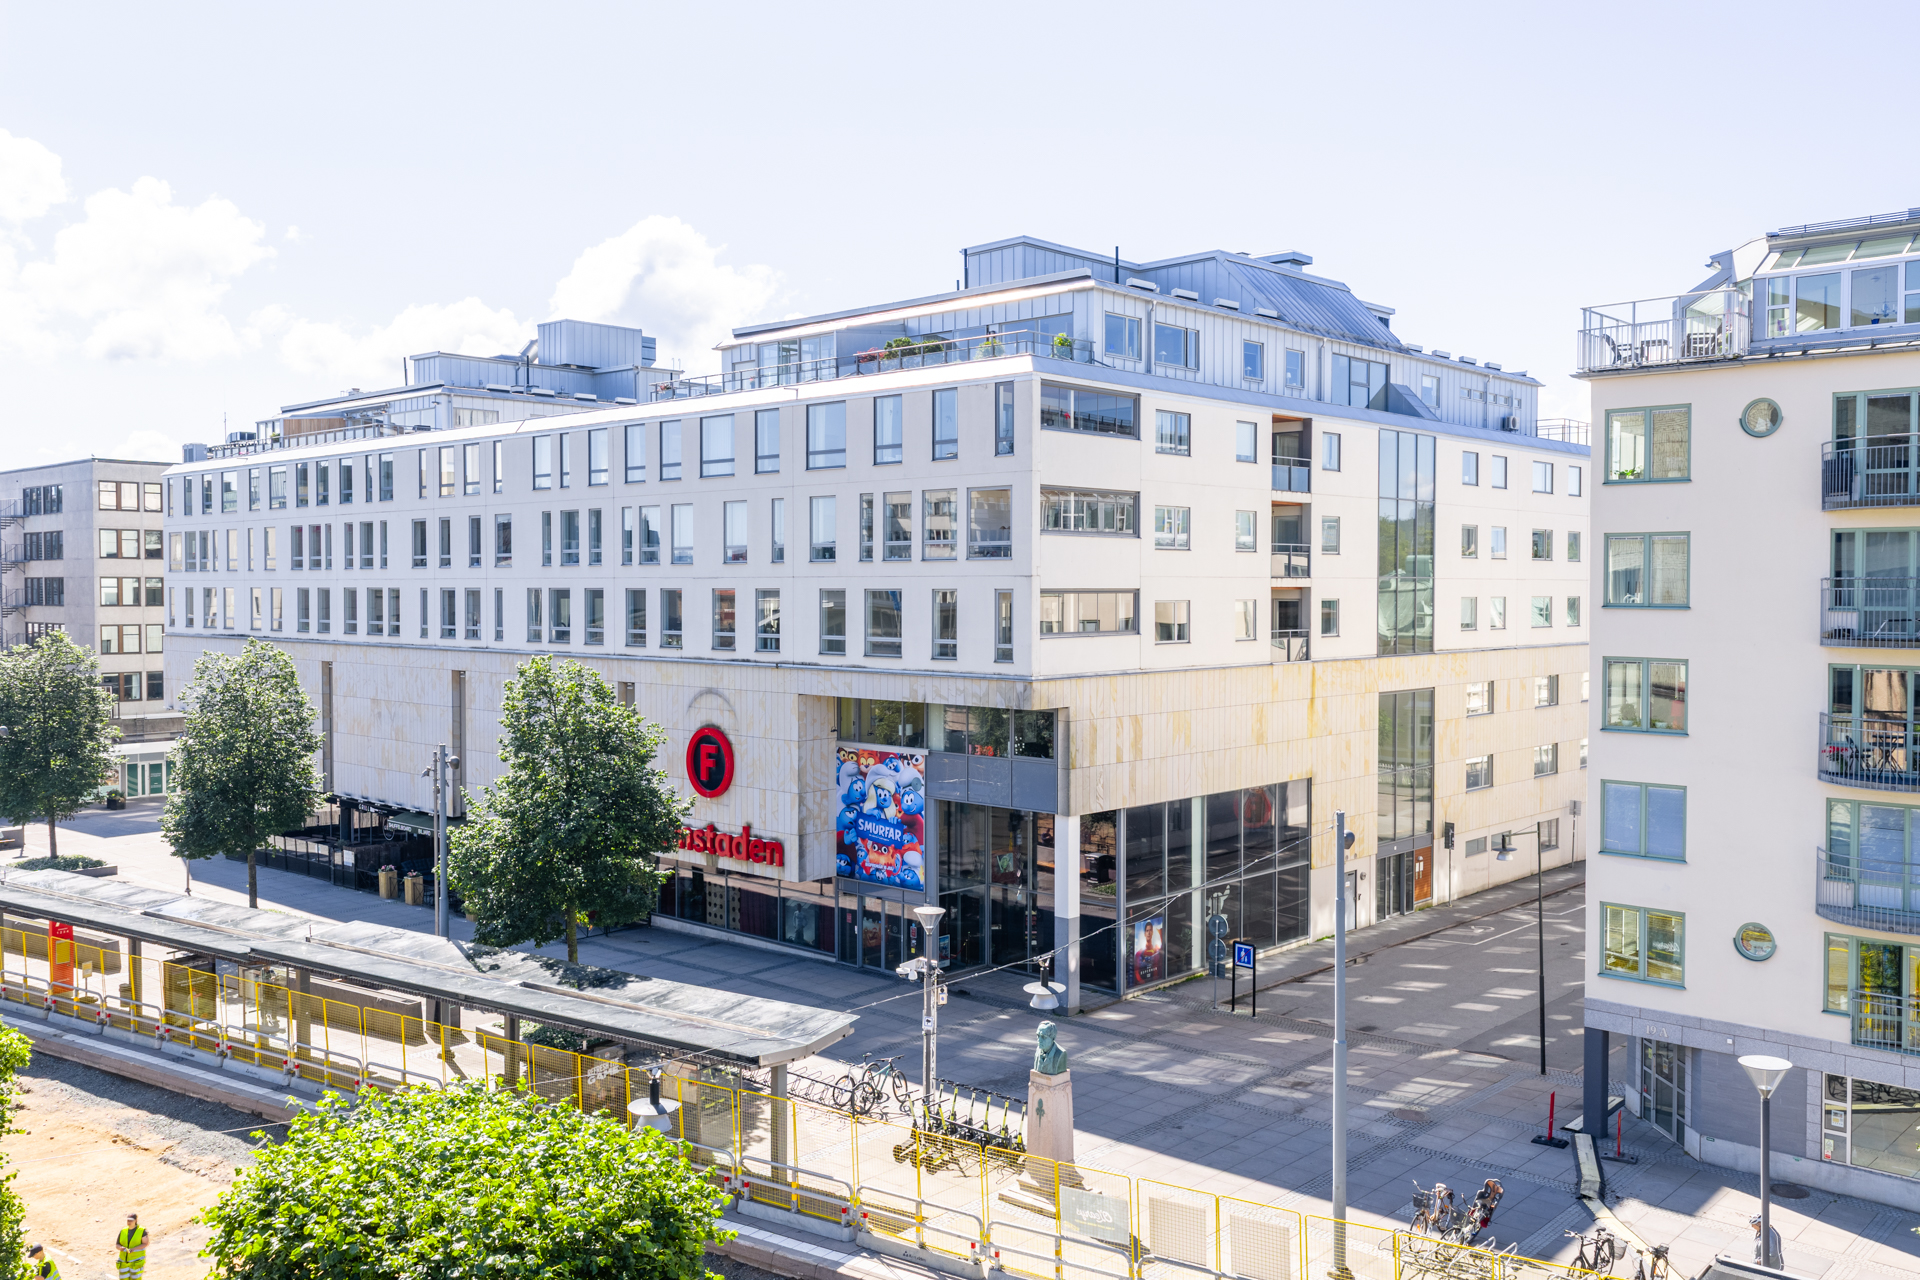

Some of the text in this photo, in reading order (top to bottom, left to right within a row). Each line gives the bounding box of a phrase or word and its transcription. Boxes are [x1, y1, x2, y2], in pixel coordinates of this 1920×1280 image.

[700, 743, 719, 781] F
[858, 818, 902, 842] SMURFAR
[1646, 1024, 1669, 1038] 19 A
